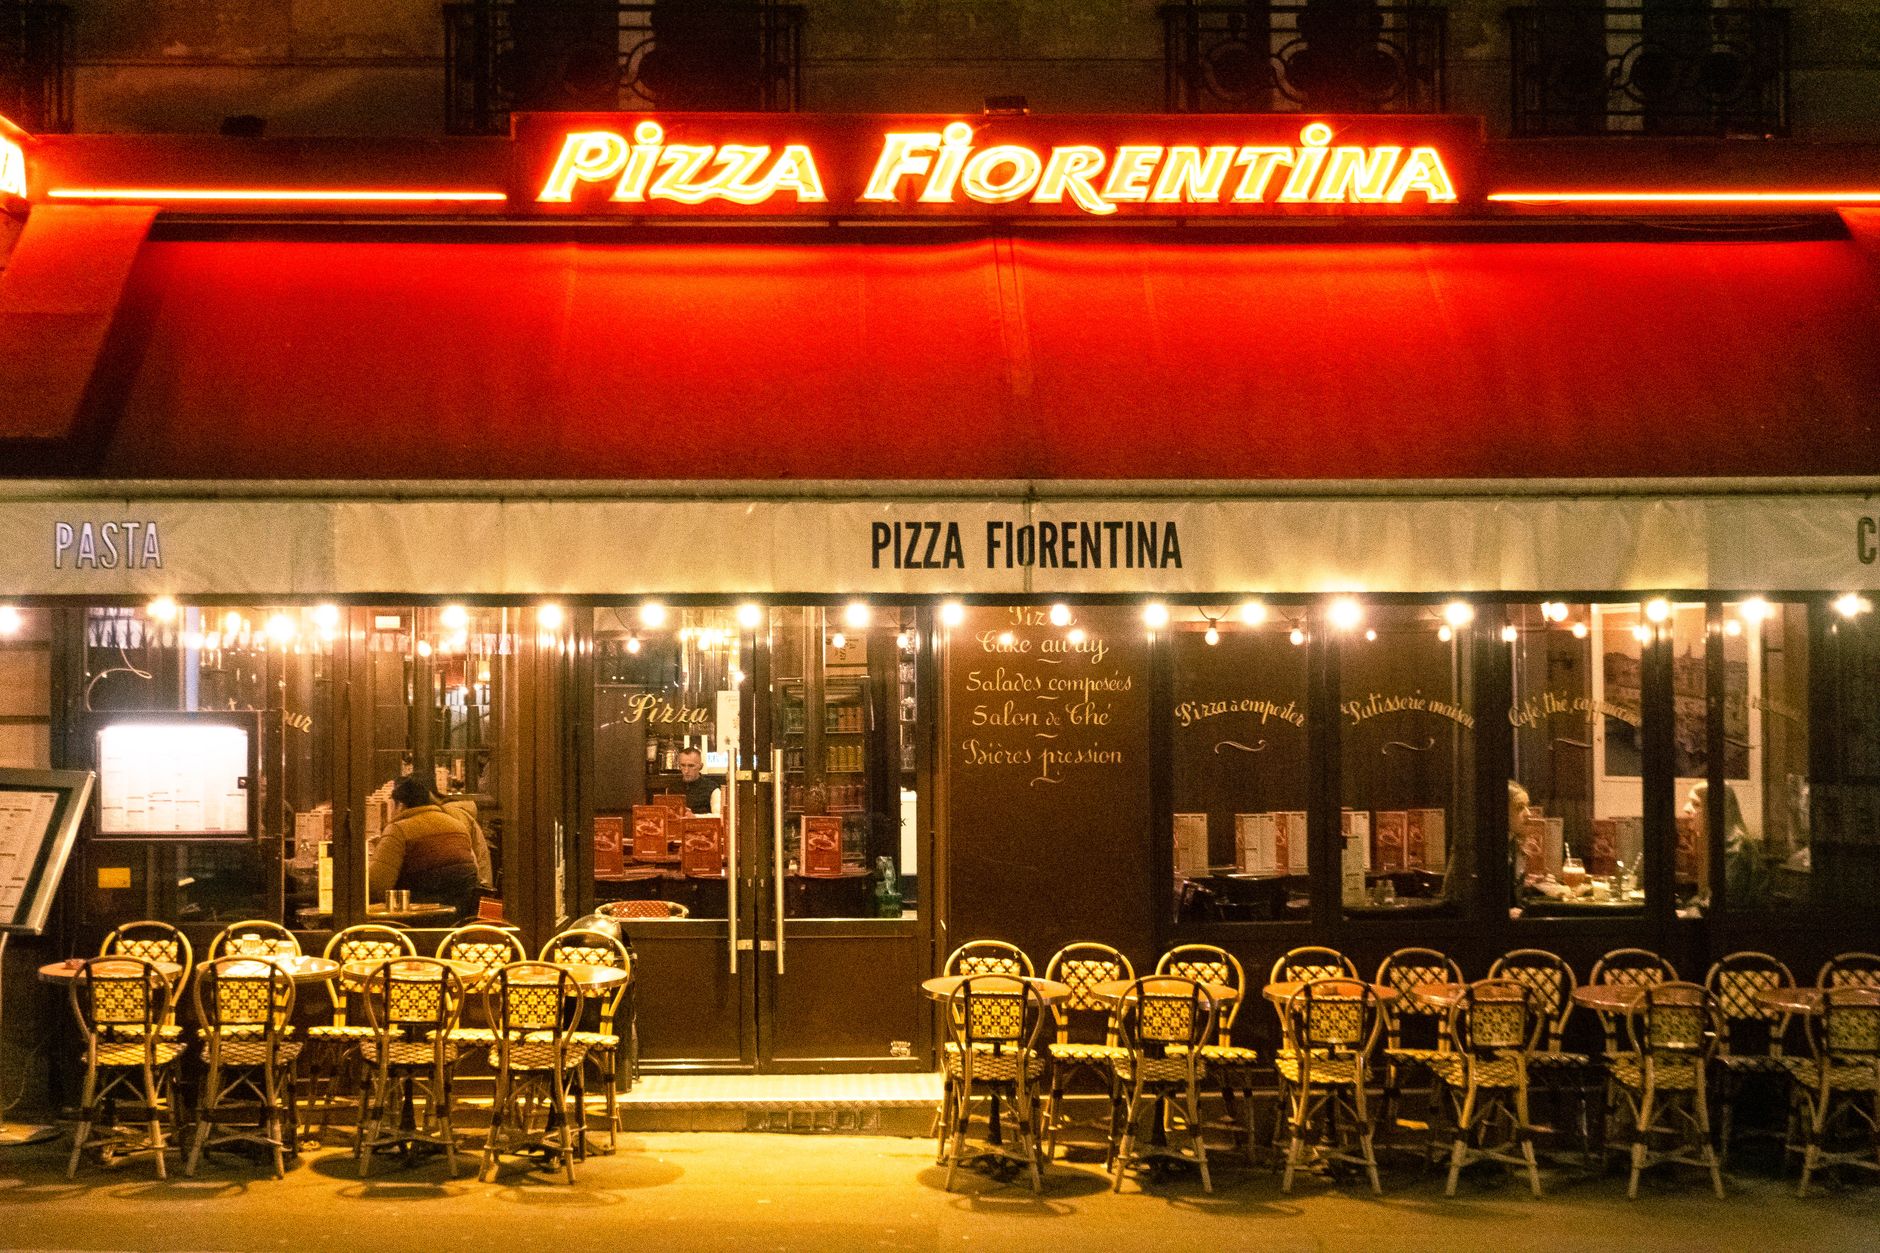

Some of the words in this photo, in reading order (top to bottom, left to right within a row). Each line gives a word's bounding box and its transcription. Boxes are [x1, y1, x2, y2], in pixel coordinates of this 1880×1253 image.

[55, 521, 163, 569] PASTA
[871, 521, 965, 569] PIZZA
[986, 521, 1184, 569] FIORENTINA
[1857, 517, 1880, 565] C
[1008, 606, 1078, 626] Piz
[966, 667, 1042, 692] Salades
[1048, 670, 1132, 703] composées
[623, 693, 708, 724] Pizza
[972, 700, 1039, 726] Salon
[1045, 712, 1061, 726] de
[1065, 702, 1112, 726] Thé
[1174, 700, 1228, 727] Pizza
[1230, 700, 1240, 712] à
[1240, 699, 1305, 727] emporter
[1428, 701, 1475, 729] maison
[962, 738, 1032, 765] Bières
[1039, 742, 1123, 777] pression
